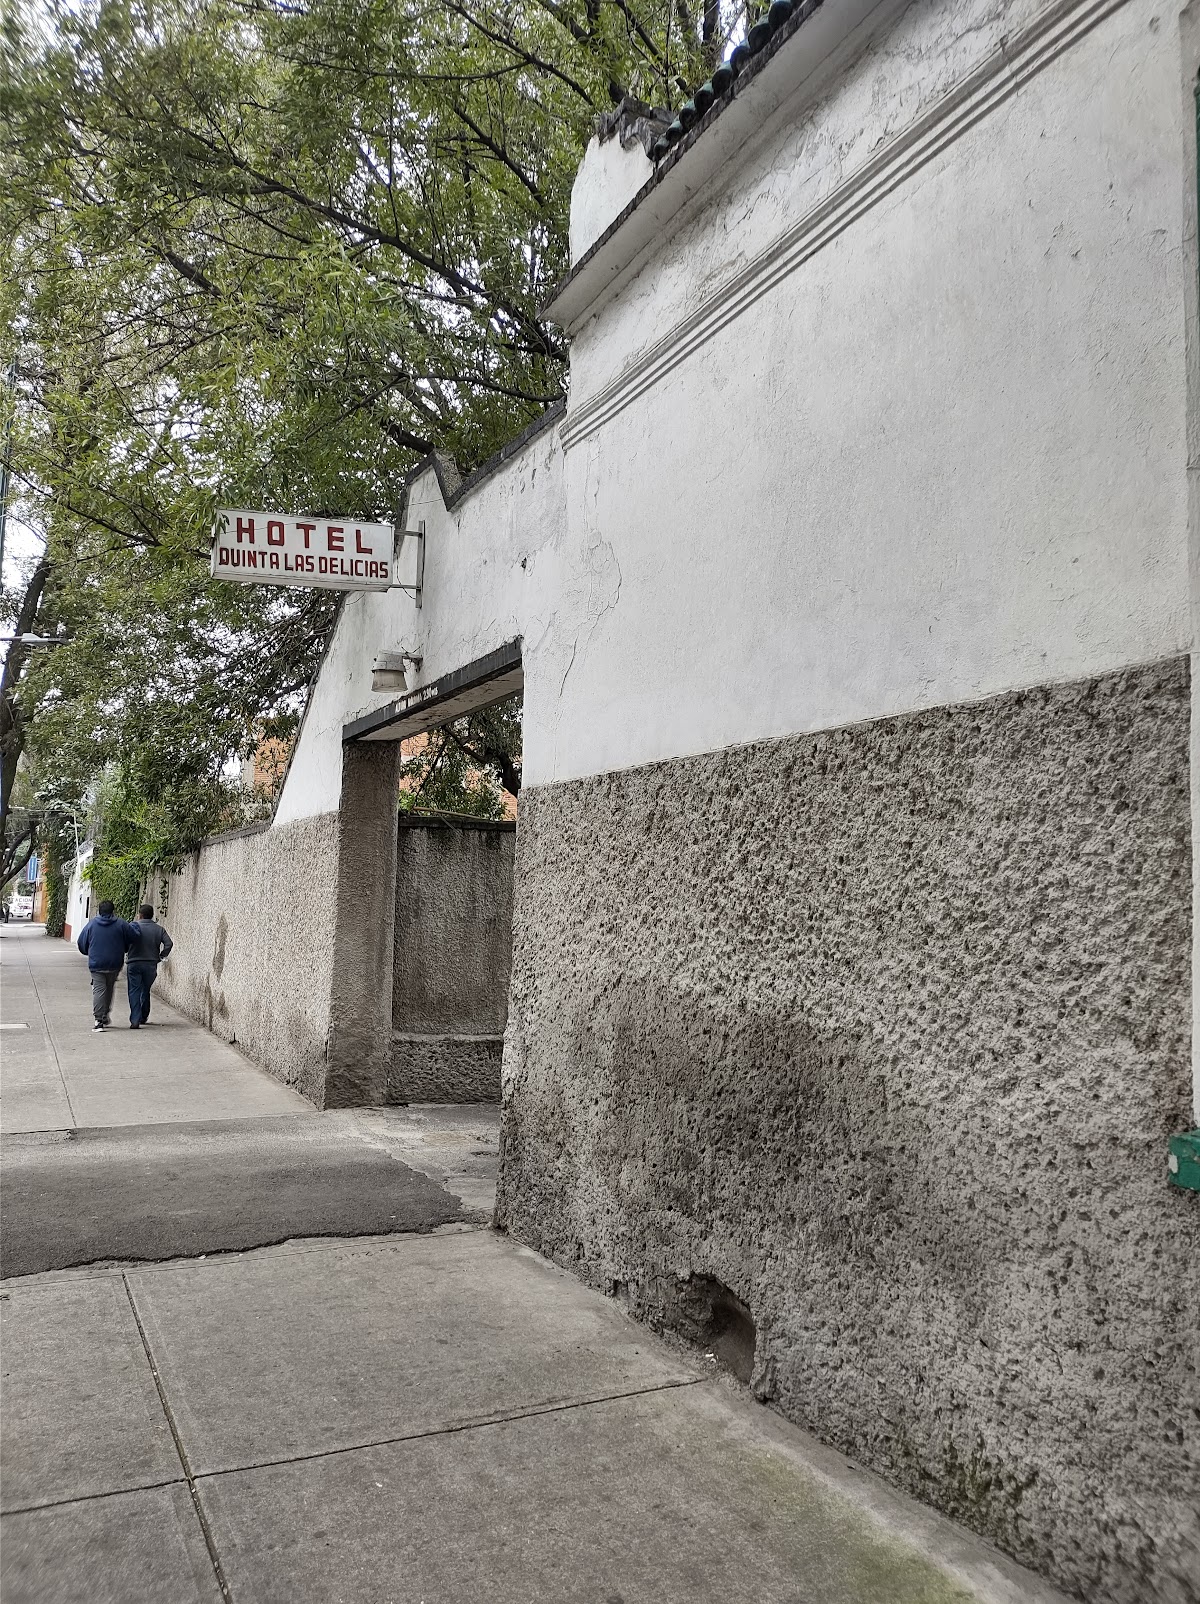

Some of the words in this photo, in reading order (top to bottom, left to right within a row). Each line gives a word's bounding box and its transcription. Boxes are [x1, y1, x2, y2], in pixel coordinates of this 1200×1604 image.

[236, 517, 373, 555] HOTEL
[285, 553, 315, 573] LAS
[319, 556, 389, 579] DELICIAS
